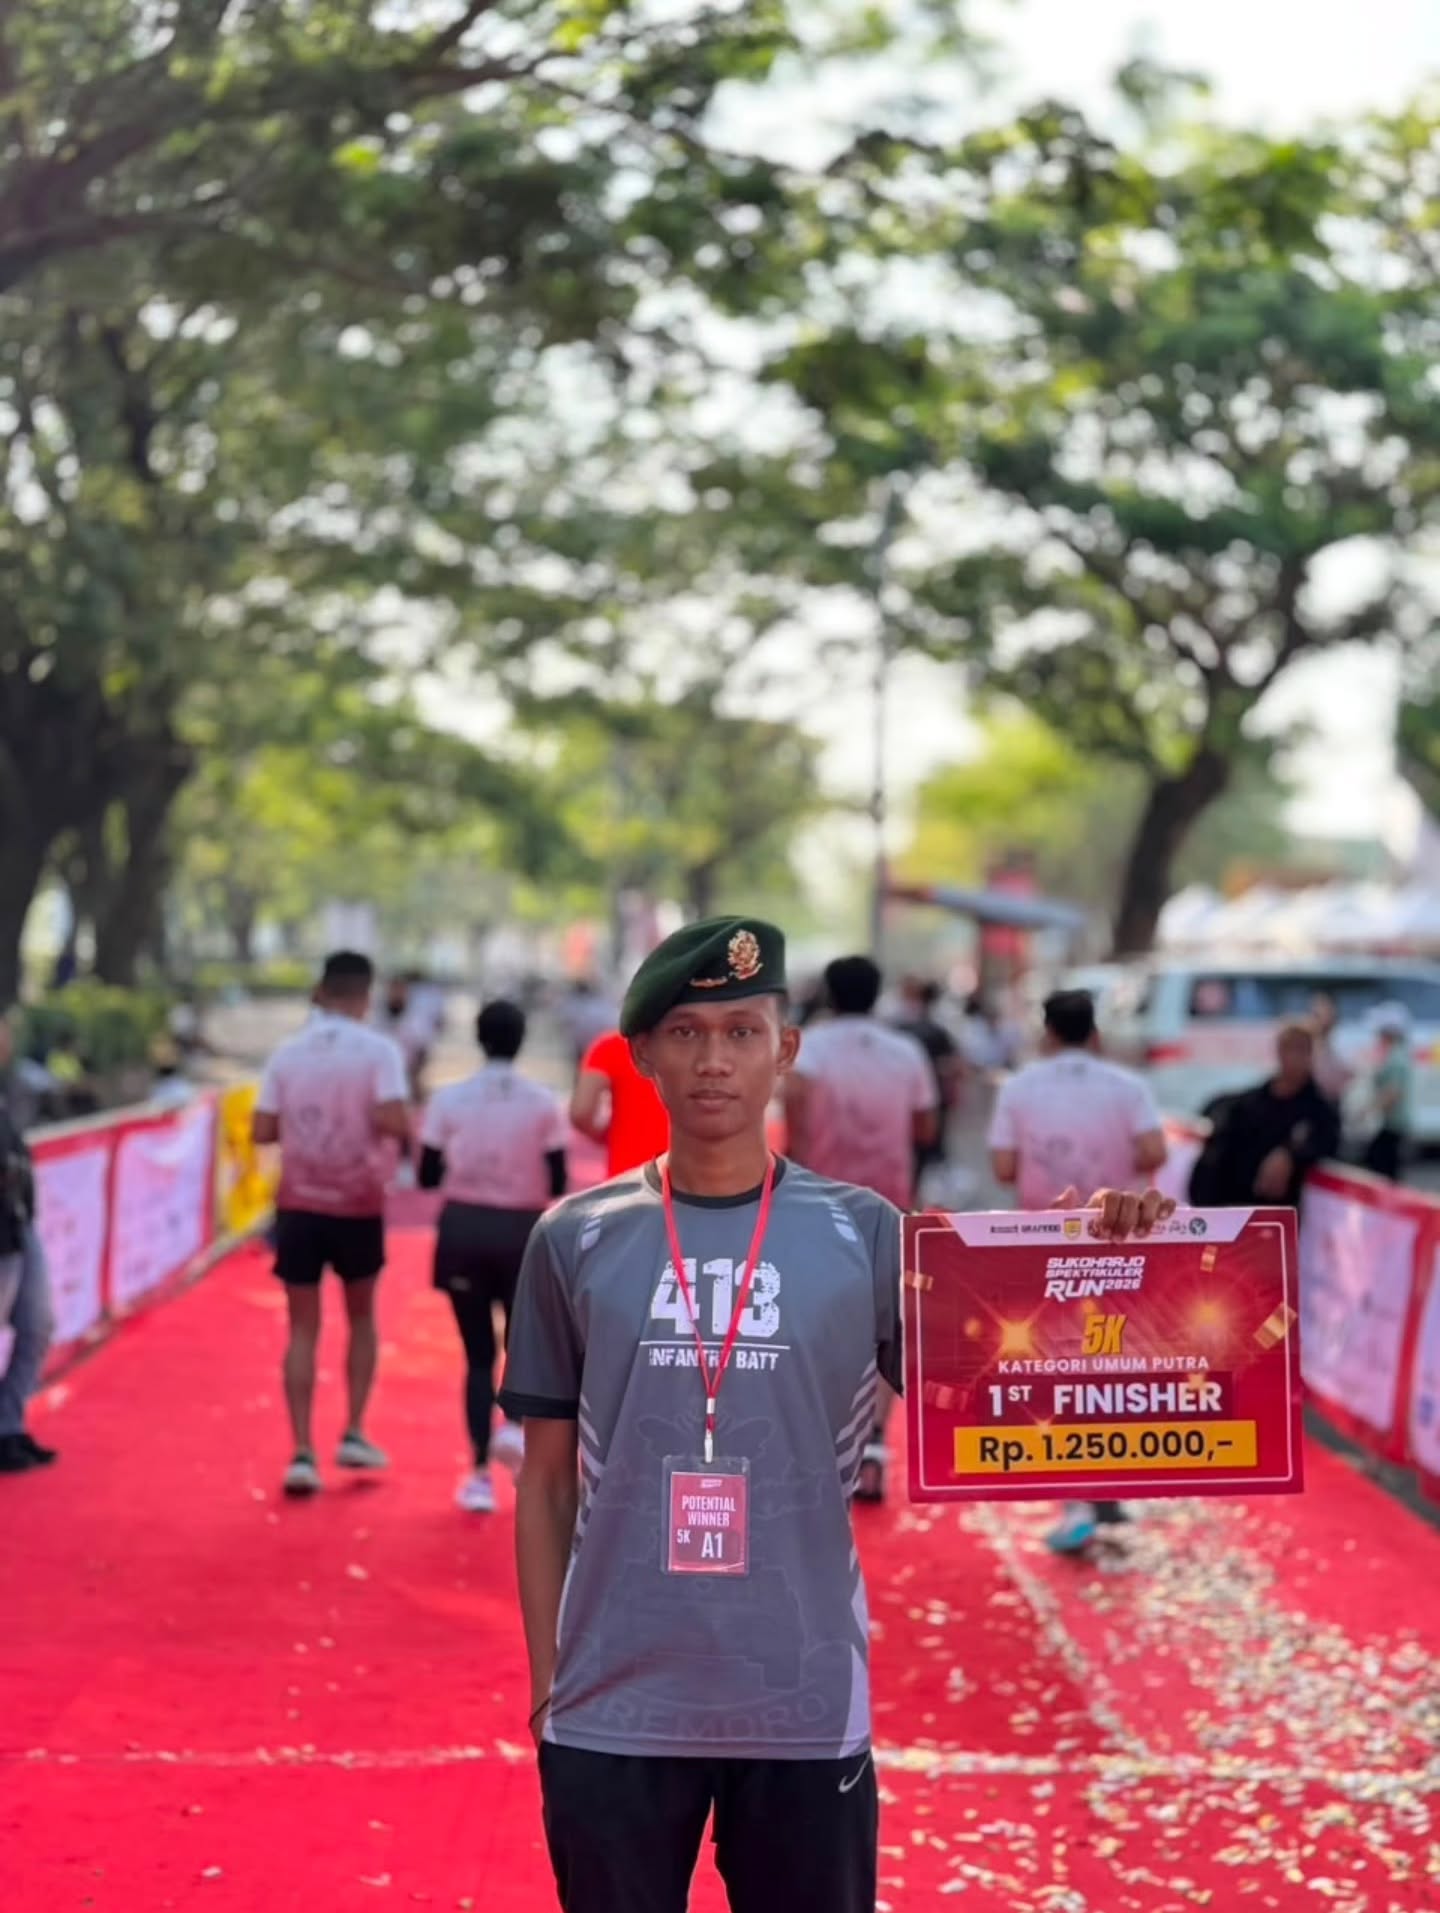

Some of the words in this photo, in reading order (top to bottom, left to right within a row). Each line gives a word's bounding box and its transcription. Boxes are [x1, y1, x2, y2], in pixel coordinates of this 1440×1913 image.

[1047, 1256, 1146, 1269] SUKOHARJO
[1045, 1268, 1144, 1279] SPEKTAKULER
[650, 1257, 782, 1338] 413
[1044, 1279, 1105, 1303] RUN
[1081, 1314, 1126, 1355] 5K
[735, 1350, 779, 1371] BATT
[998, 1358, 1087, 1374] KATEGORI
[1092, 1357, 1147, 1372] UMUM
[1152, 1356, 1209, 1371] PUTRA
[1053, 1382, 1223, 1415] FINISHER
[979, 1435, 1034, 1471] Rp.
[681, 1495, 736, 1511] POTENTIAL
[687, 1511, 730, 1527] WINNER
[676, 1528, 691, 1544] 5K
[701, 1531, 724, 1559] A1
